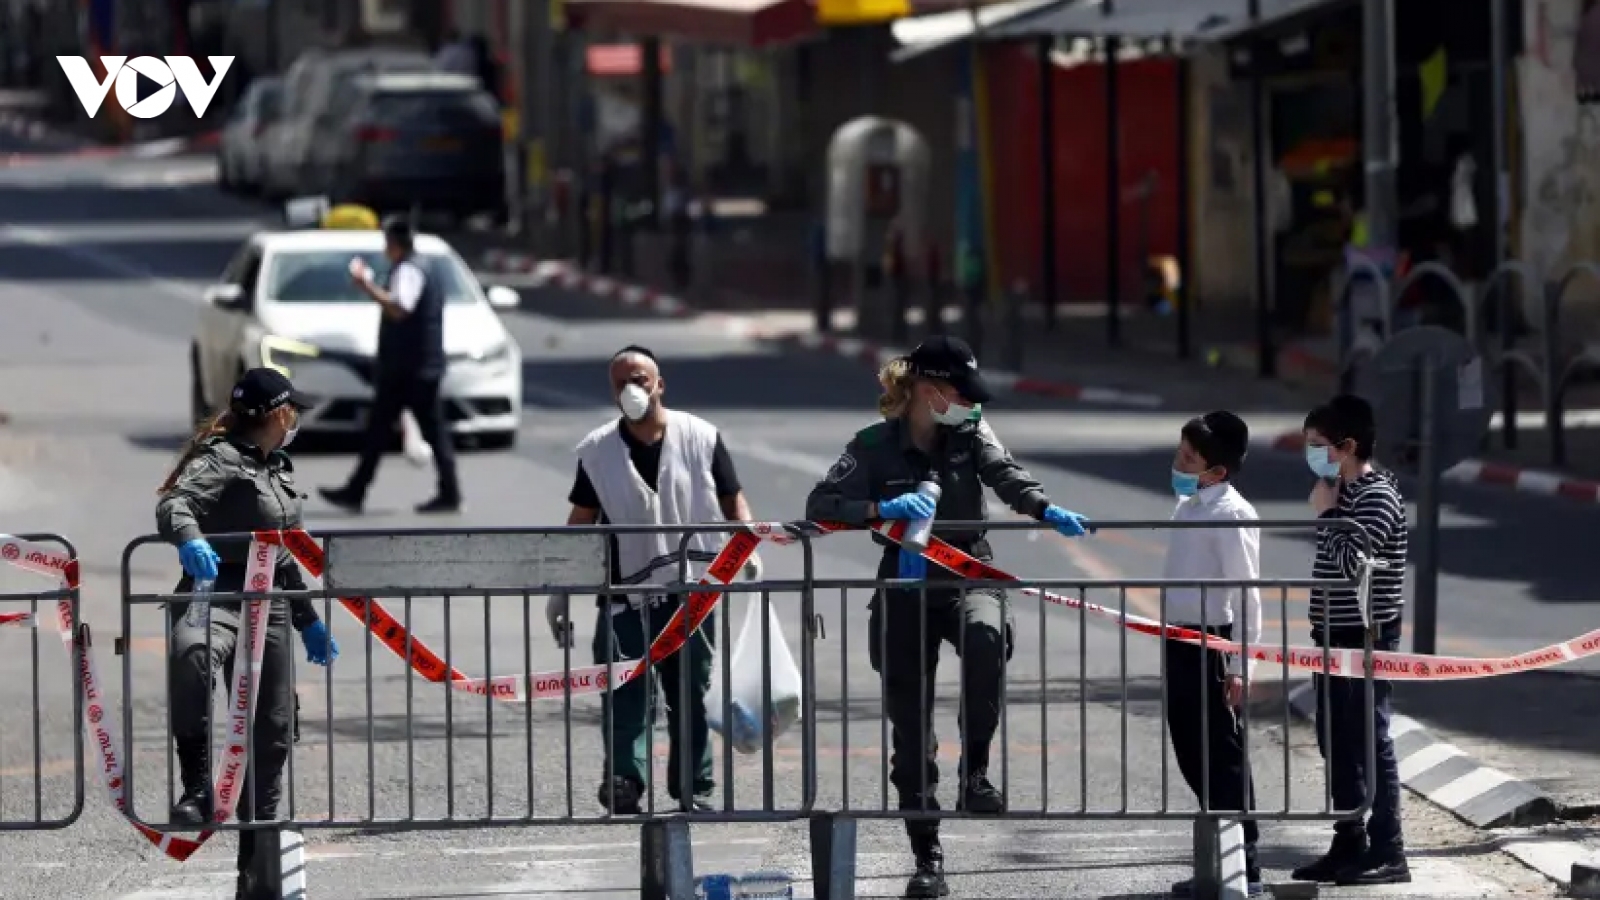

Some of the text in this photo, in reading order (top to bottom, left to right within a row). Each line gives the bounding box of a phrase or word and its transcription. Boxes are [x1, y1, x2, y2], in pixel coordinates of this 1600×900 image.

[1276, 652, 1340, 668] אן מער
[1362, 657, 1410, 673] שטרת
[219, 762, 241, 804] ישראל
